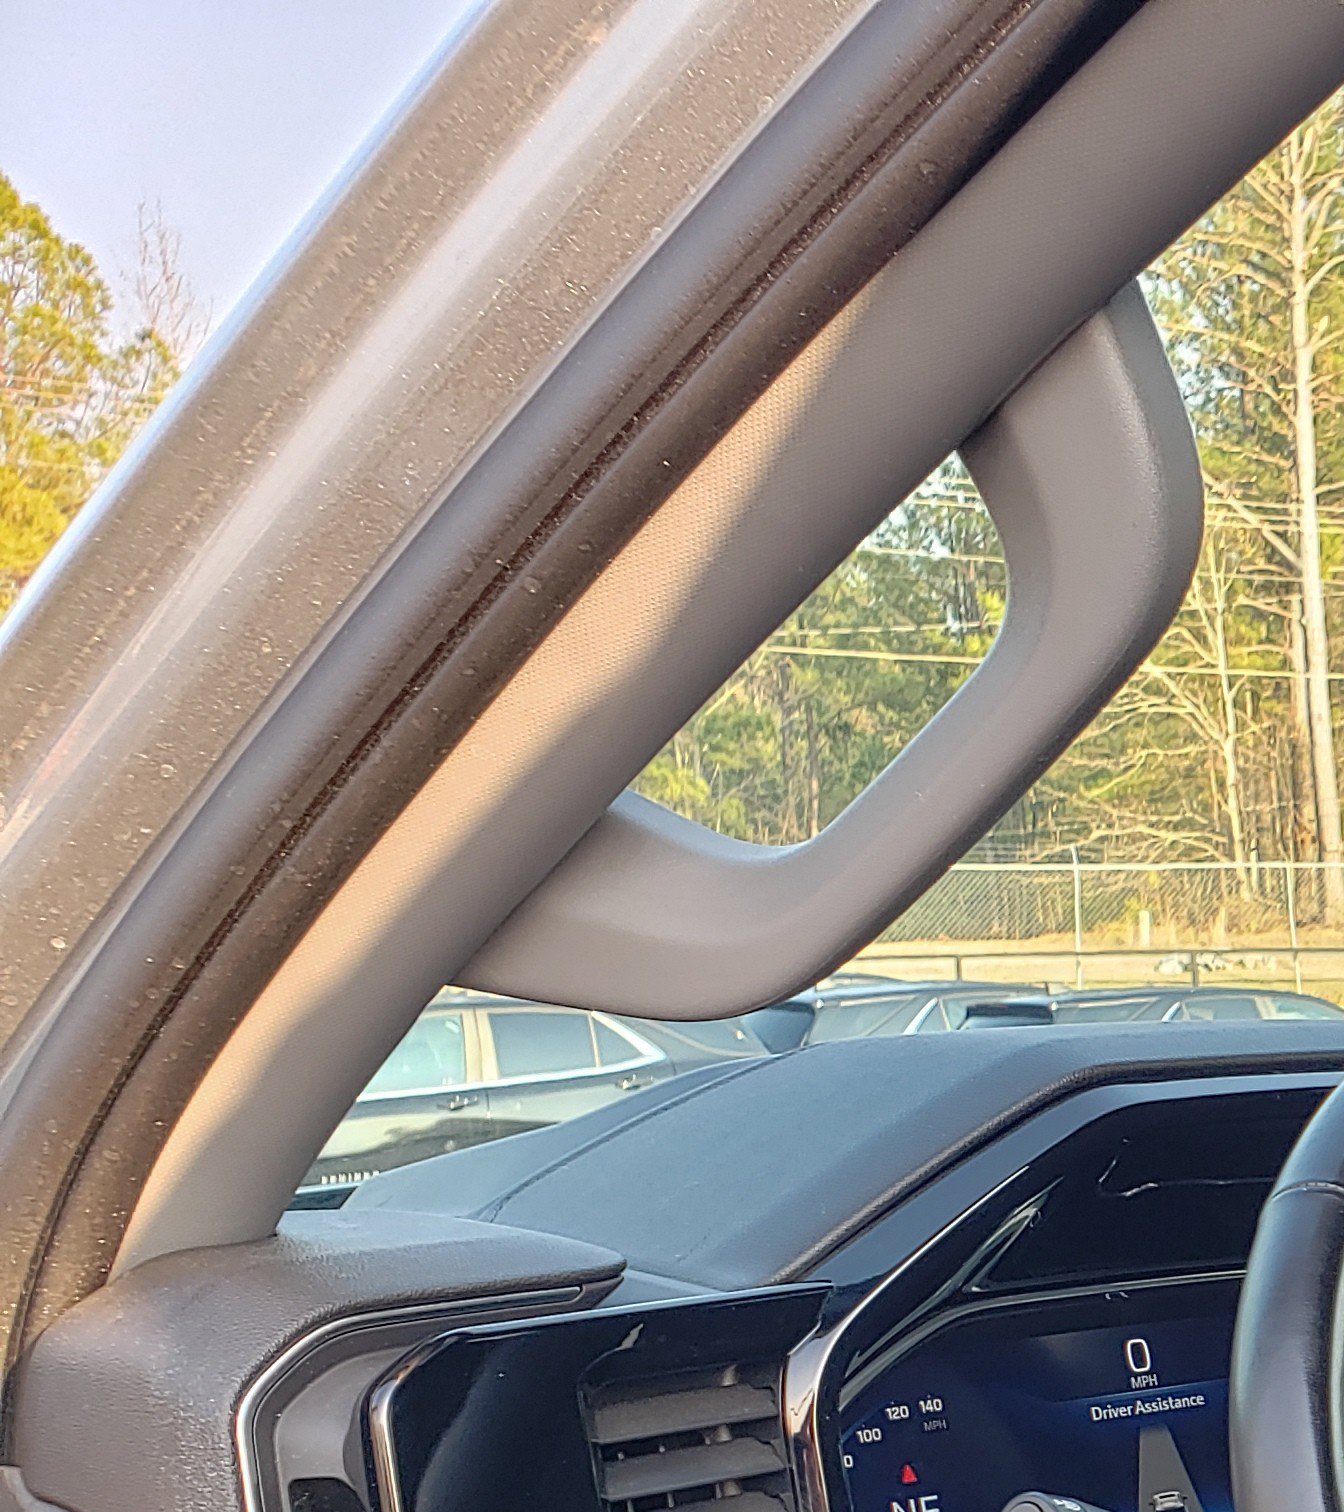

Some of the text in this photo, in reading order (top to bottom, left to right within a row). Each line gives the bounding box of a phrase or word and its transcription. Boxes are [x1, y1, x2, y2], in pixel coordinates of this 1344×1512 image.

[1124, 1338, 1151, 1372] 0
[1130, 1374, 1158, 1389] MPH
[885, 1405, 910, 1421] 120
[918, 1398, 943, 1414] 140
[1090, 1395, 1205, 1421] Driver Assistance
[923, 1419, 947, 1432] MPH
[856, 1427, 882, 1444] 100
